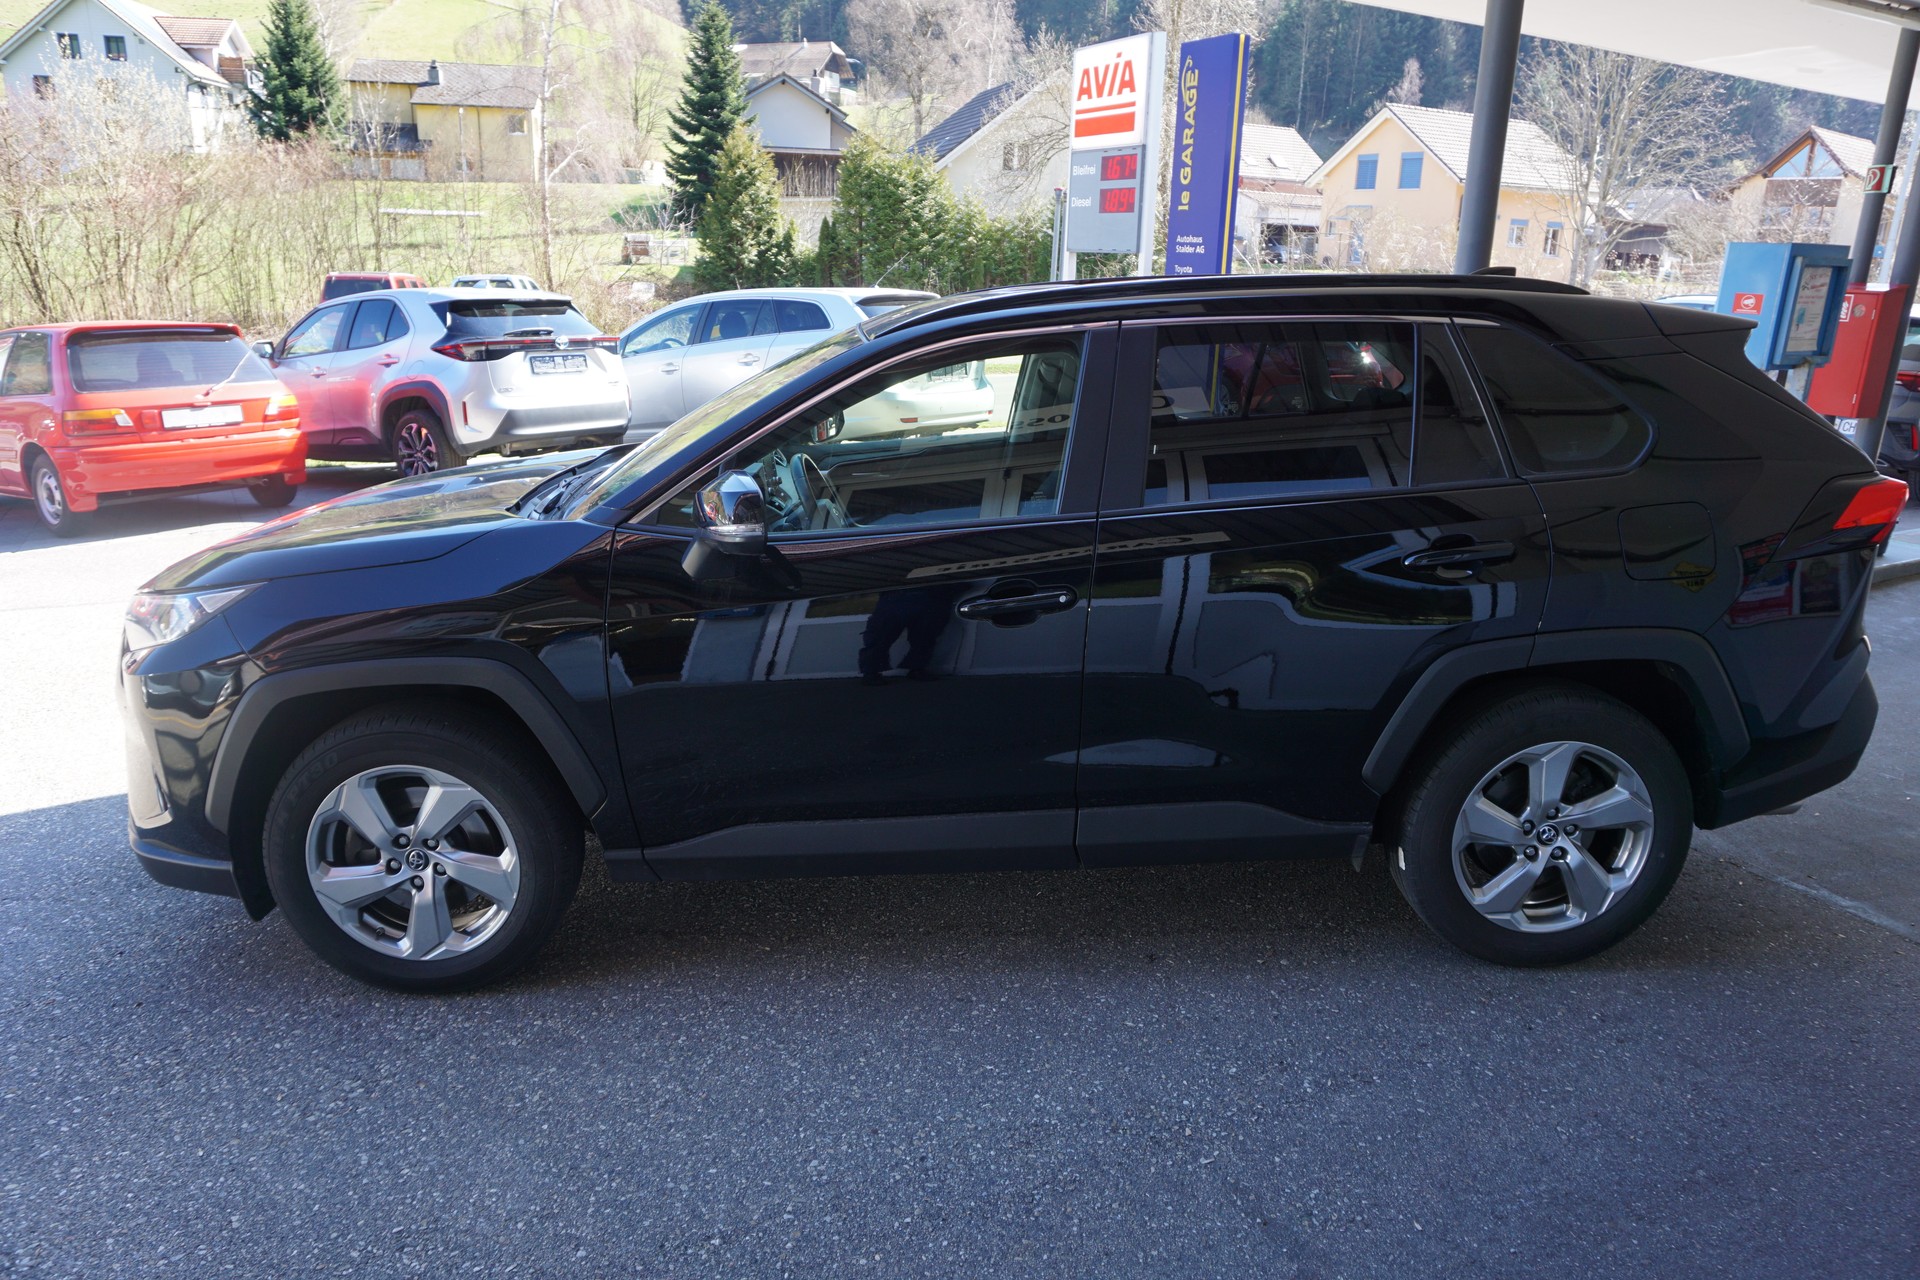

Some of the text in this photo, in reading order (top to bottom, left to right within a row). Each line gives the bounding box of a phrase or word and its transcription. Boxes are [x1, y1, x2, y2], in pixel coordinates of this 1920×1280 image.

[1180, 68, 1199, 185] GARAGE
[1073, 164, 1096, 176] Bleifrei
[1071, 196, 1092, 207] Diesel
[1176, 235, 1203, 243] Autohaus
[1175, 244, 1205, 253] Stalder AG
[1174, 264, 1193, 274] Toyota
